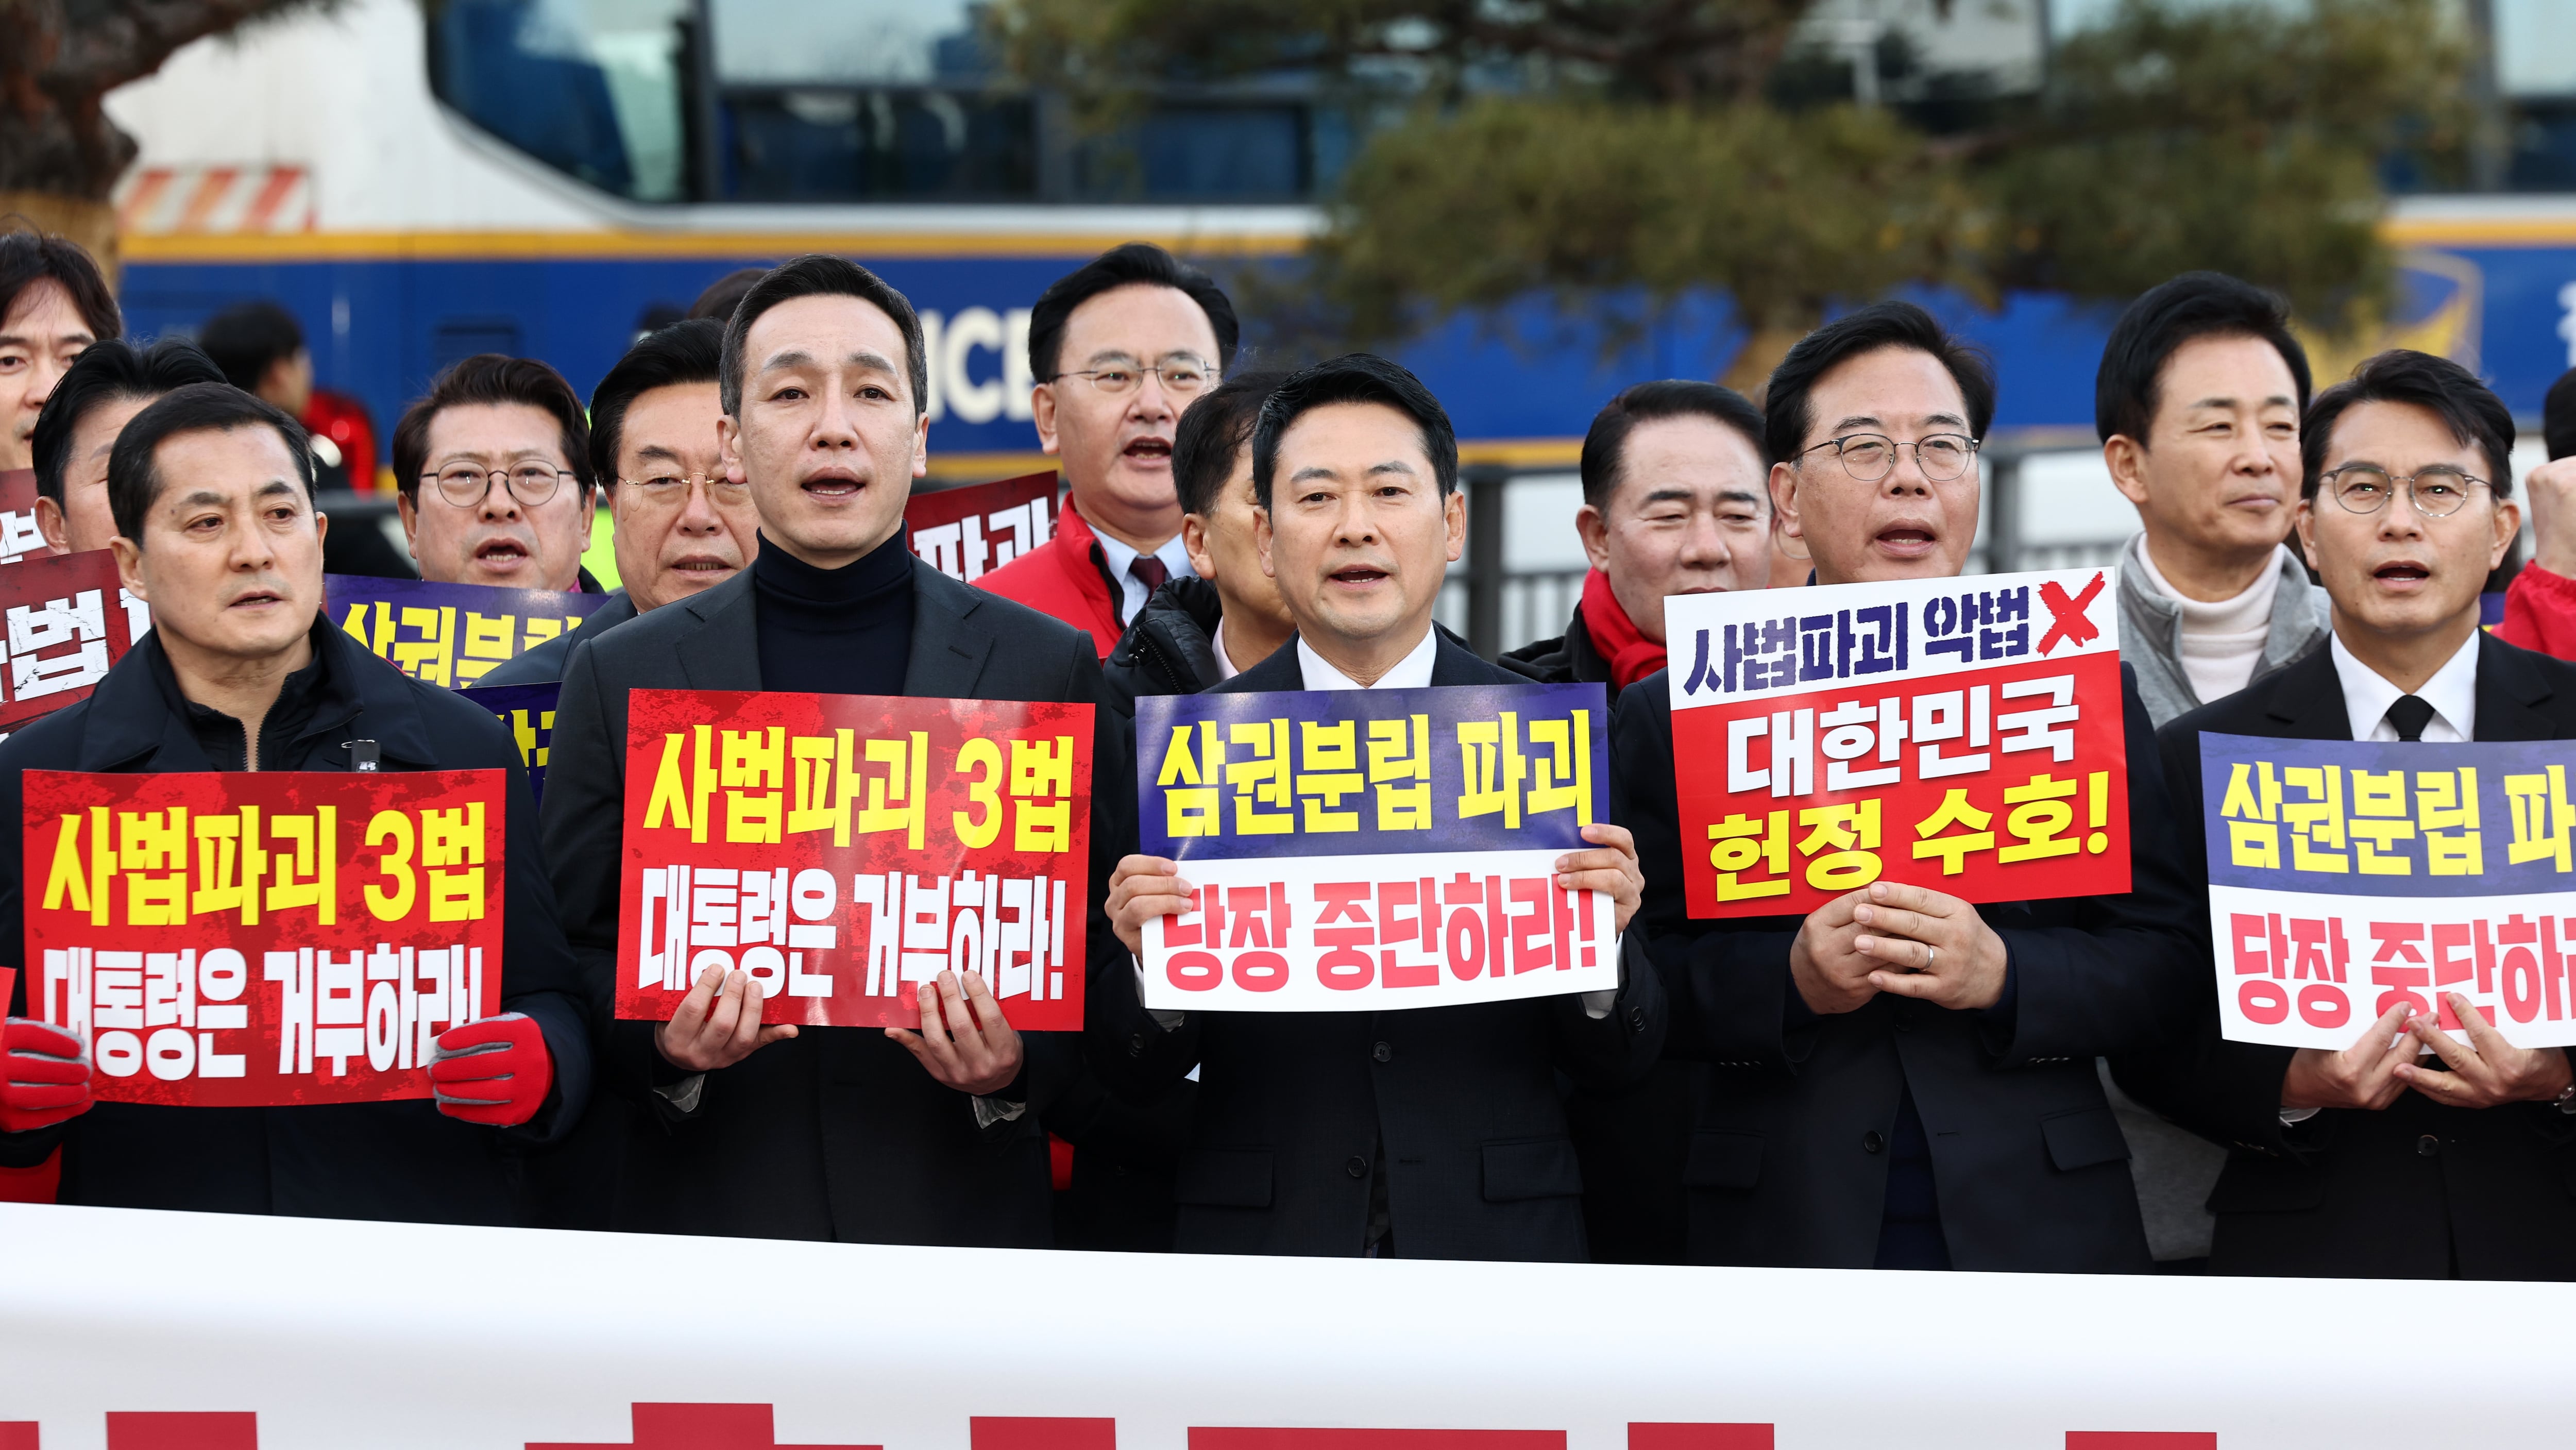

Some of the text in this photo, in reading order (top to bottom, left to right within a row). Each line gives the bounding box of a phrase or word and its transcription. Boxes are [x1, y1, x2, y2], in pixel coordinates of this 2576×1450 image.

[1683, 586, 2029, 696] 사법파괴 악법
[643, 724, 928, 850] 사법파괴
[953, 736, 1074, 852] 3법
[1157, 710, 1592, 837] 삼권분립 파괴
[1727, 674, 2079, 798] 대한민국
[42, 802, 485, 926] 사법파괴 3법
[1708, 771, 2109, 902] 헌정 수호!
[2221, 761, 2483, 875] 삼권분립
[639, 865, 1066, 1000] 대통령은 거부하라!
[1162, 872, 1597, 992] 당장 중단하라!
[2230, 913, 2576, 1034] 당장 중단하
[43, 947, 247, 1081] 대통령은
